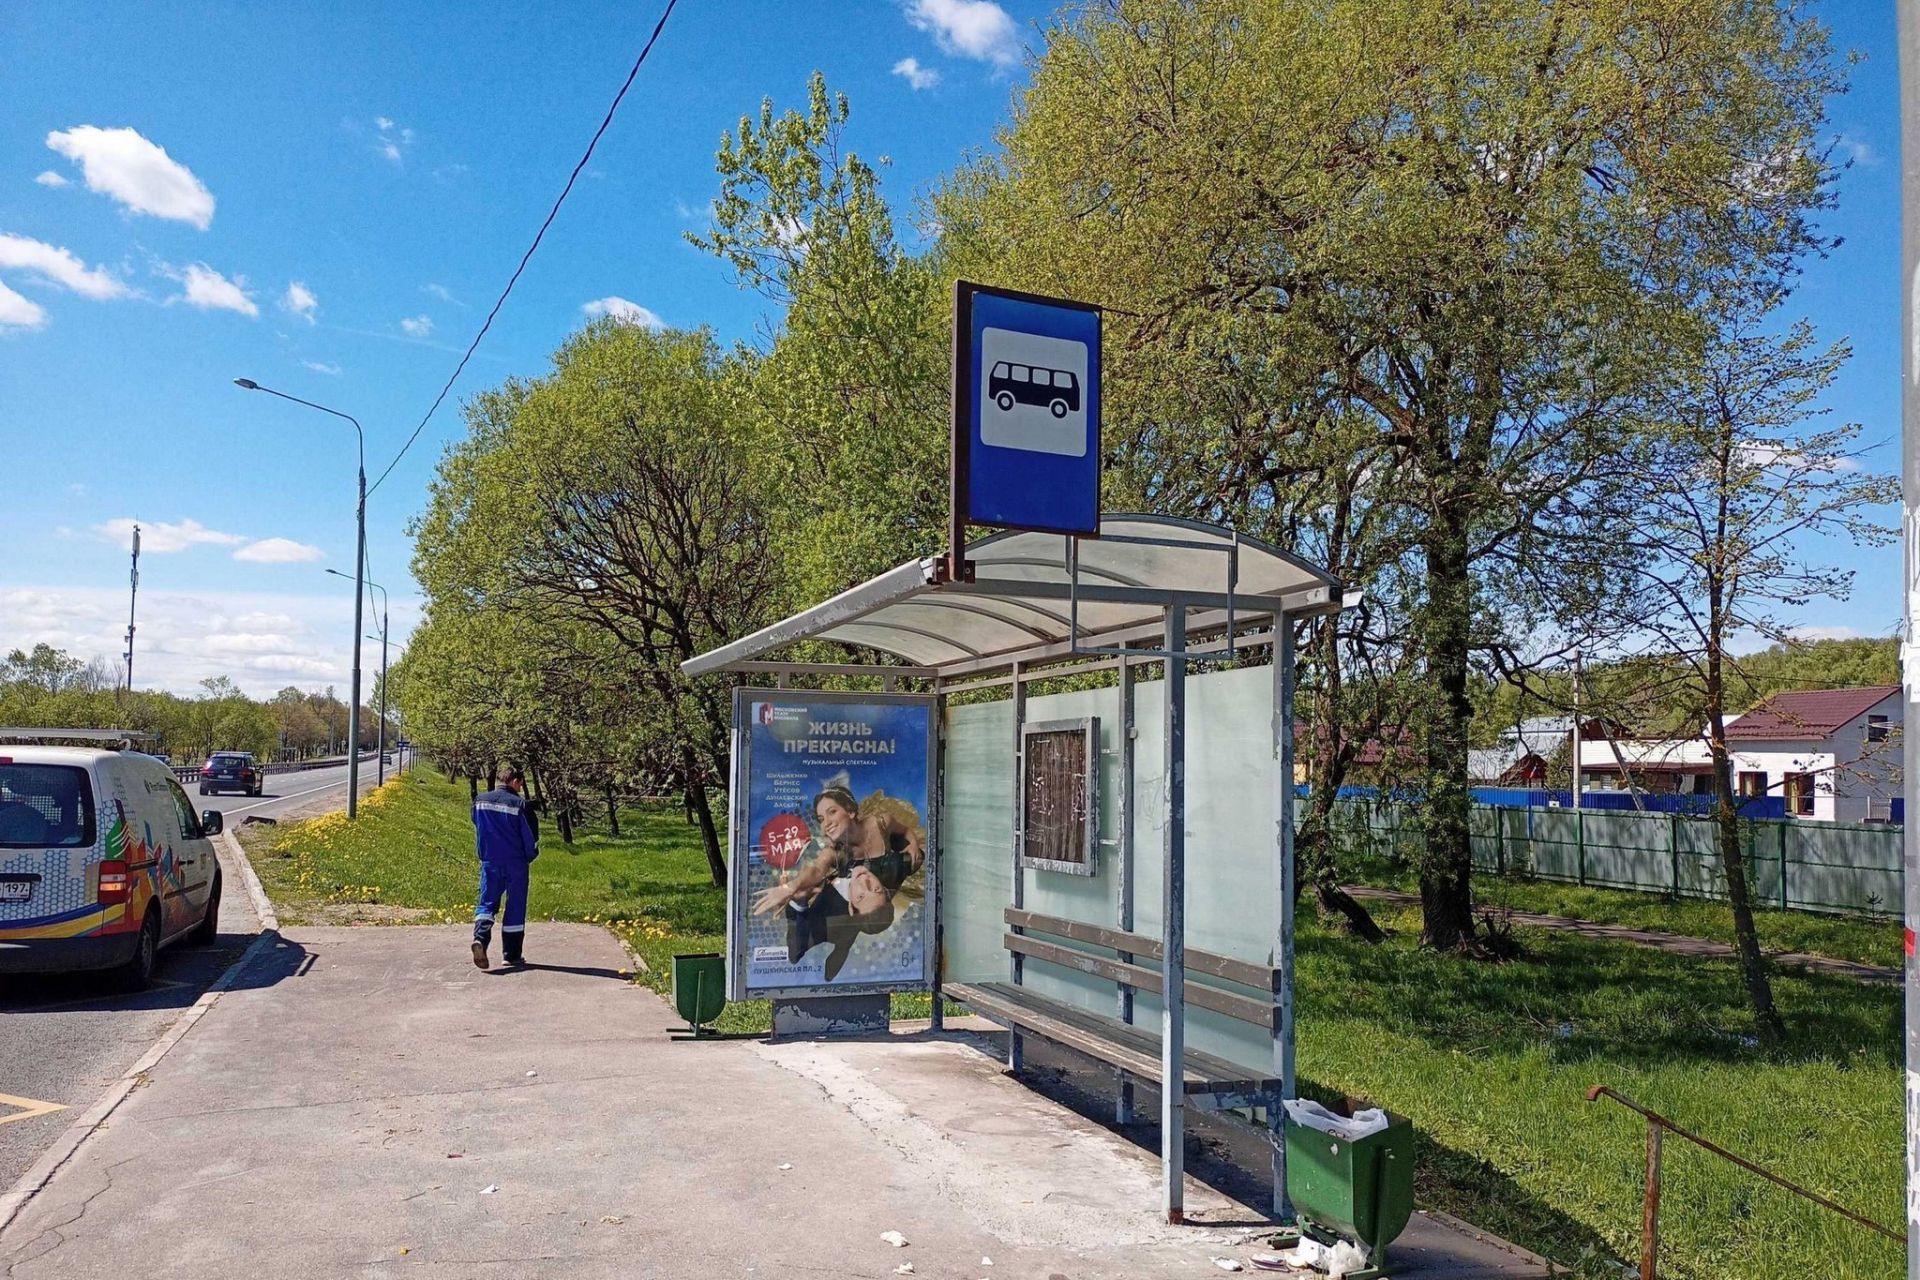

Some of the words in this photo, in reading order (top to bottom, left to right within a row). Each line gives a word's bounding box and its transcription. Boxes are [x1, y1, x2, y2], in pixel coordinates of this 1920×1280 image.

[808, 721, 873, 735] ЖИЗНЬ
[783, 738, 896, 754] ПРЕКРАСНА!
[770, 837, 802, 857] МАЯ
[5, 883, 26, 893] 197
[901, 951, 917, 968] 6+
[753, 966, 802, 975] ПУШКИНСКАЯ
